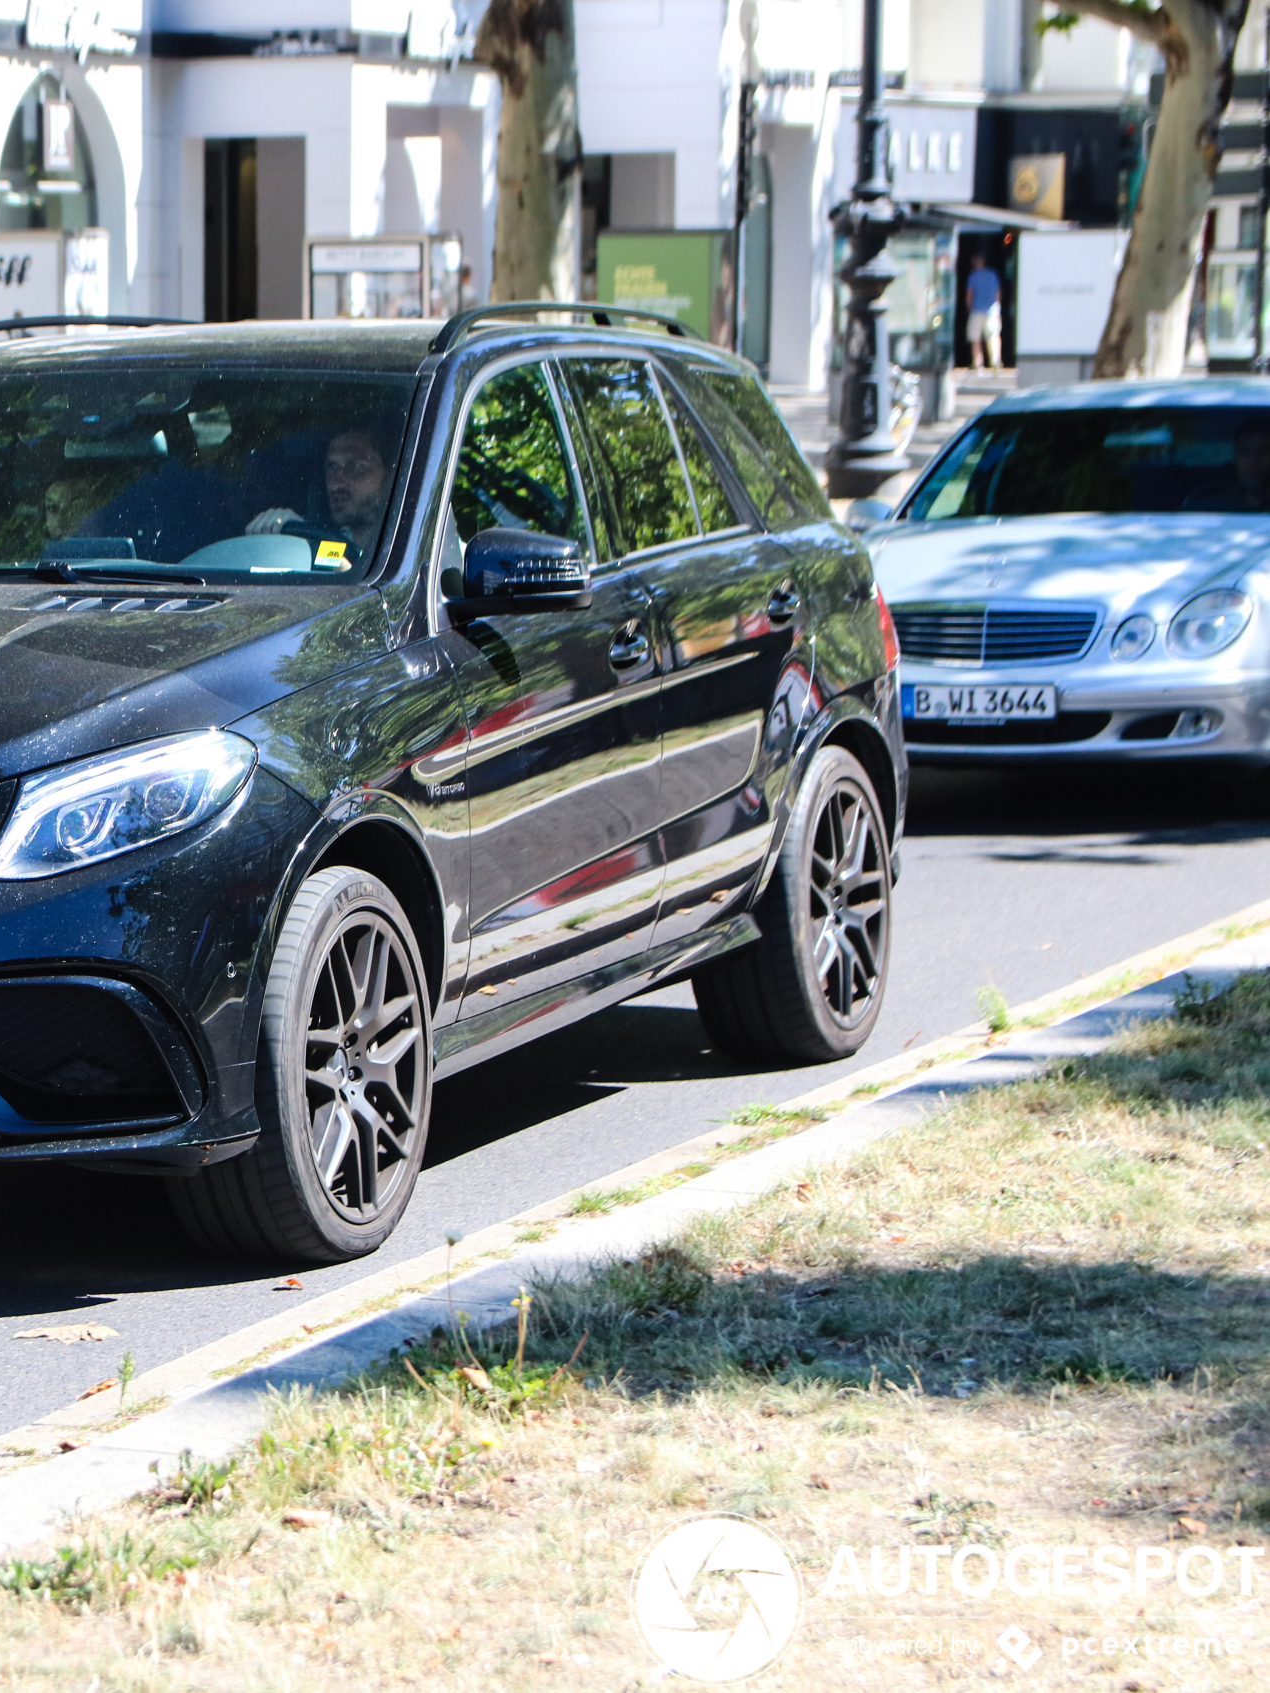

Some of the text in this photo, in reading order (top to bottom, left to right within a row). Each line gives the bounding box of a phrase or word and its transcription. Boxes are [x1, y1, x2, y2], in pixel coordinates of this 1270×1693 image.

[888, 129, 963, 172] ALKE
[915, 690, 1048, 714] B WI 3644
